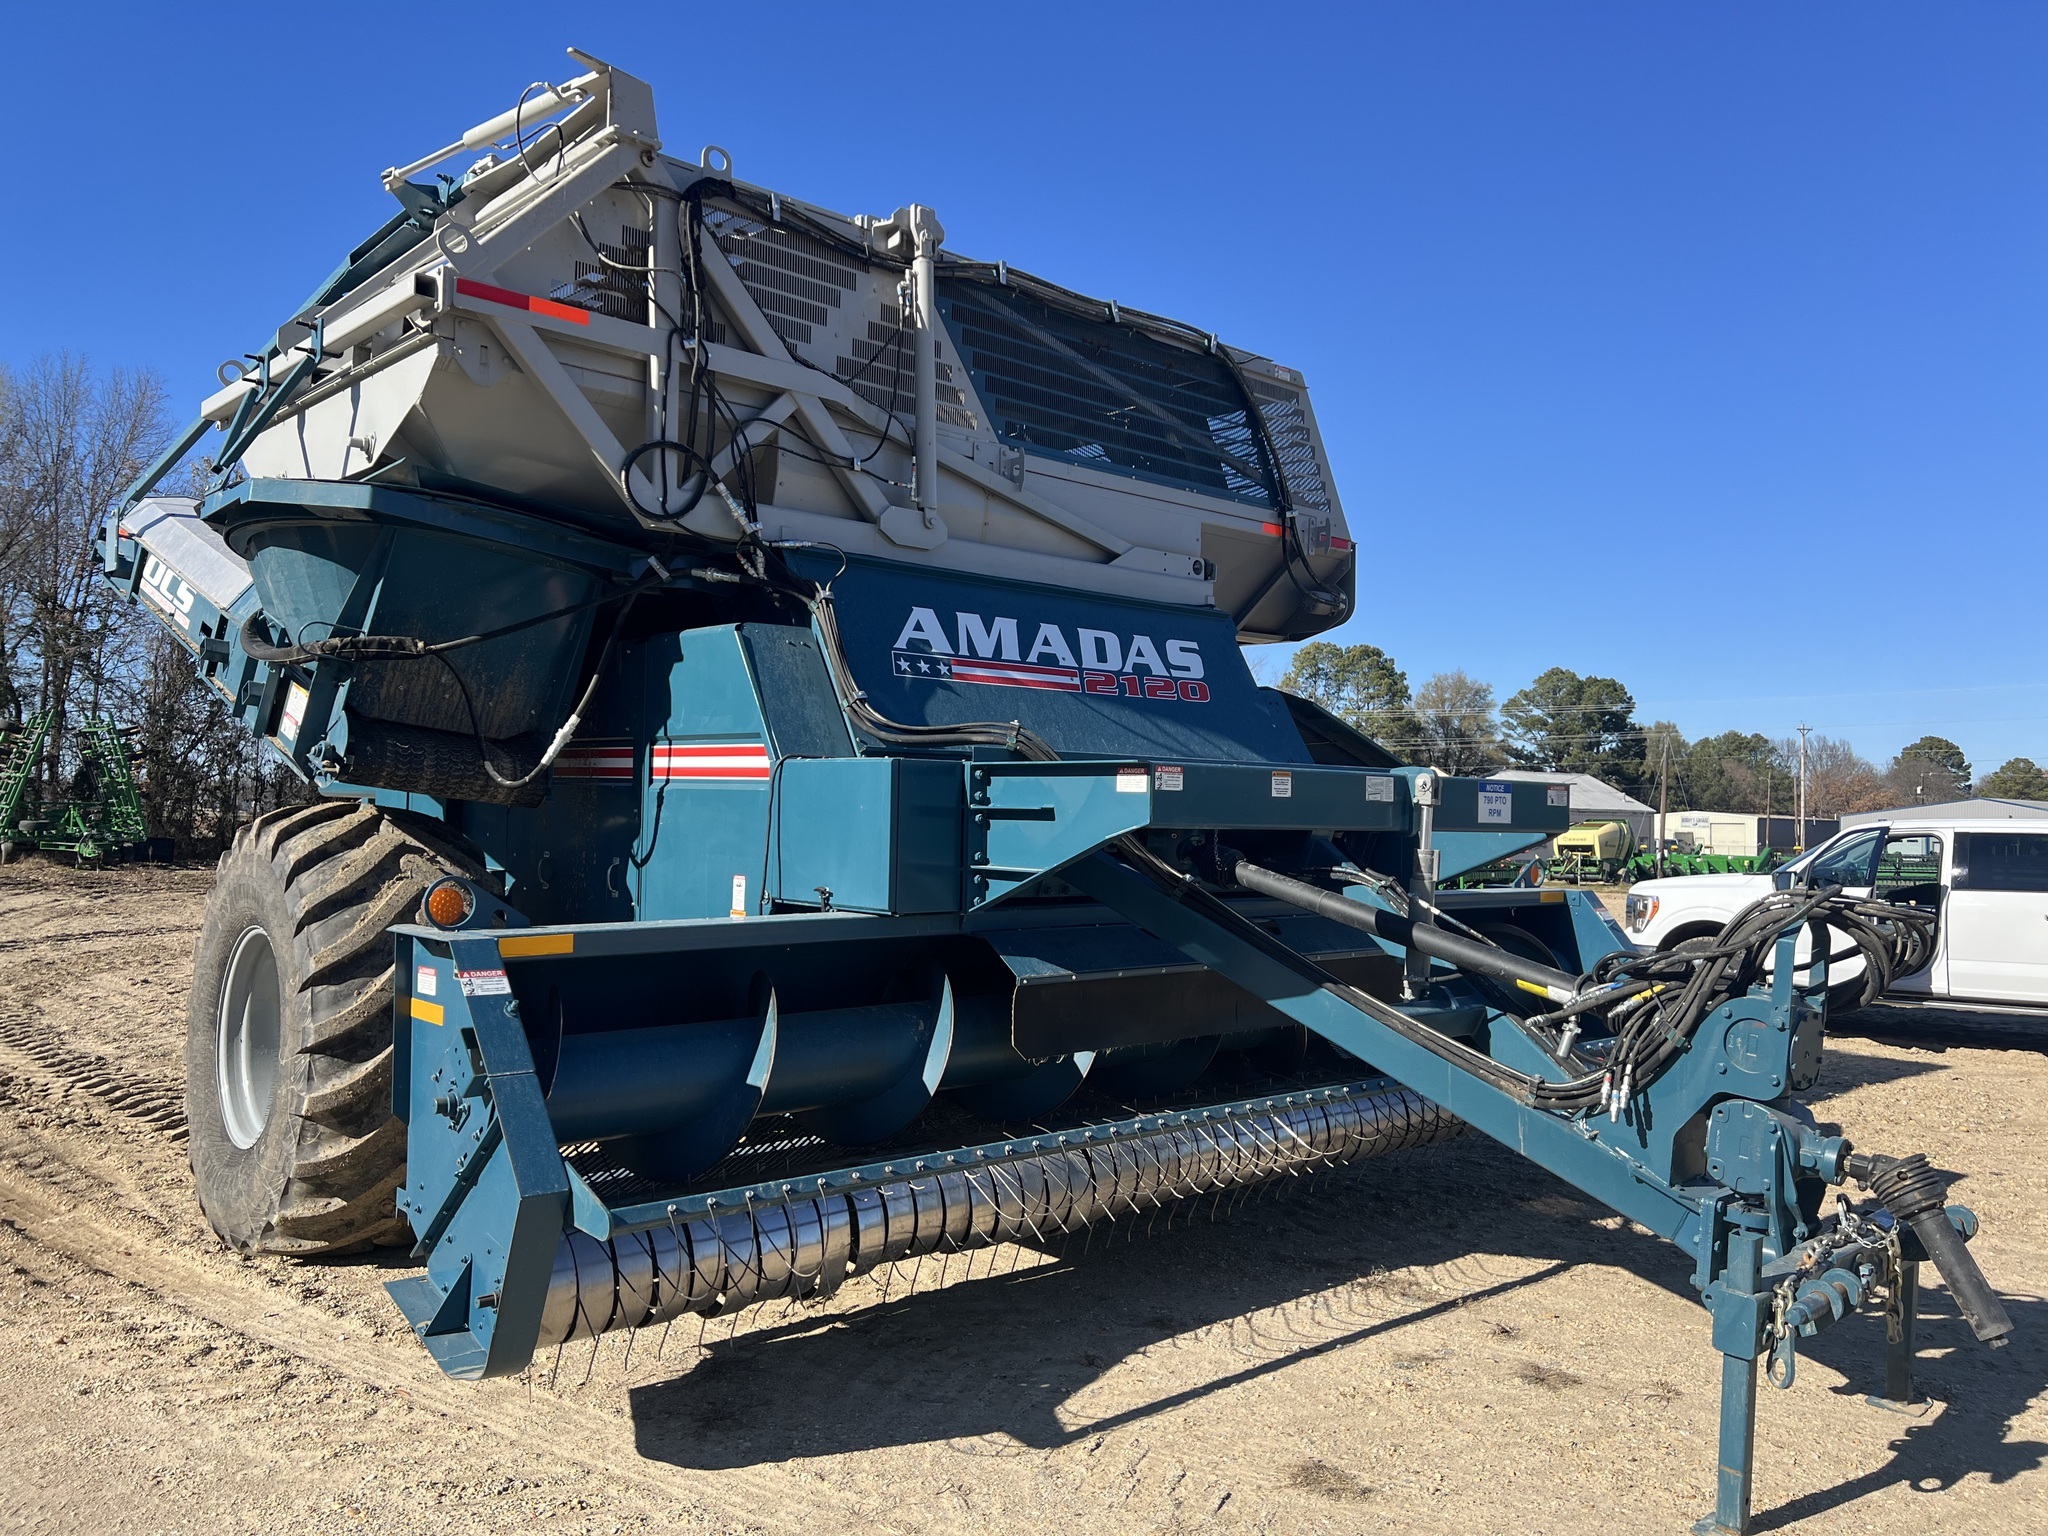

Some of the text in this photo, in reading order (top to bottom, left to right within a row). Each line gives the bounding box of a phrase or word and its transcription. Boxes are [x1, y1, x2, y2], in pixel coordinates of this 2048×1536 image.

[893, 606, 1205, 679] AMADAS
[1082, 670, 1211, 703] 2120
[1486, 784, 1505, 793] NOTICE
[1483, 796, 1507, 805] 790 PTO
[1488, 808, 1502, 817] RPM
[470, 970, 503, 978] DANGER
